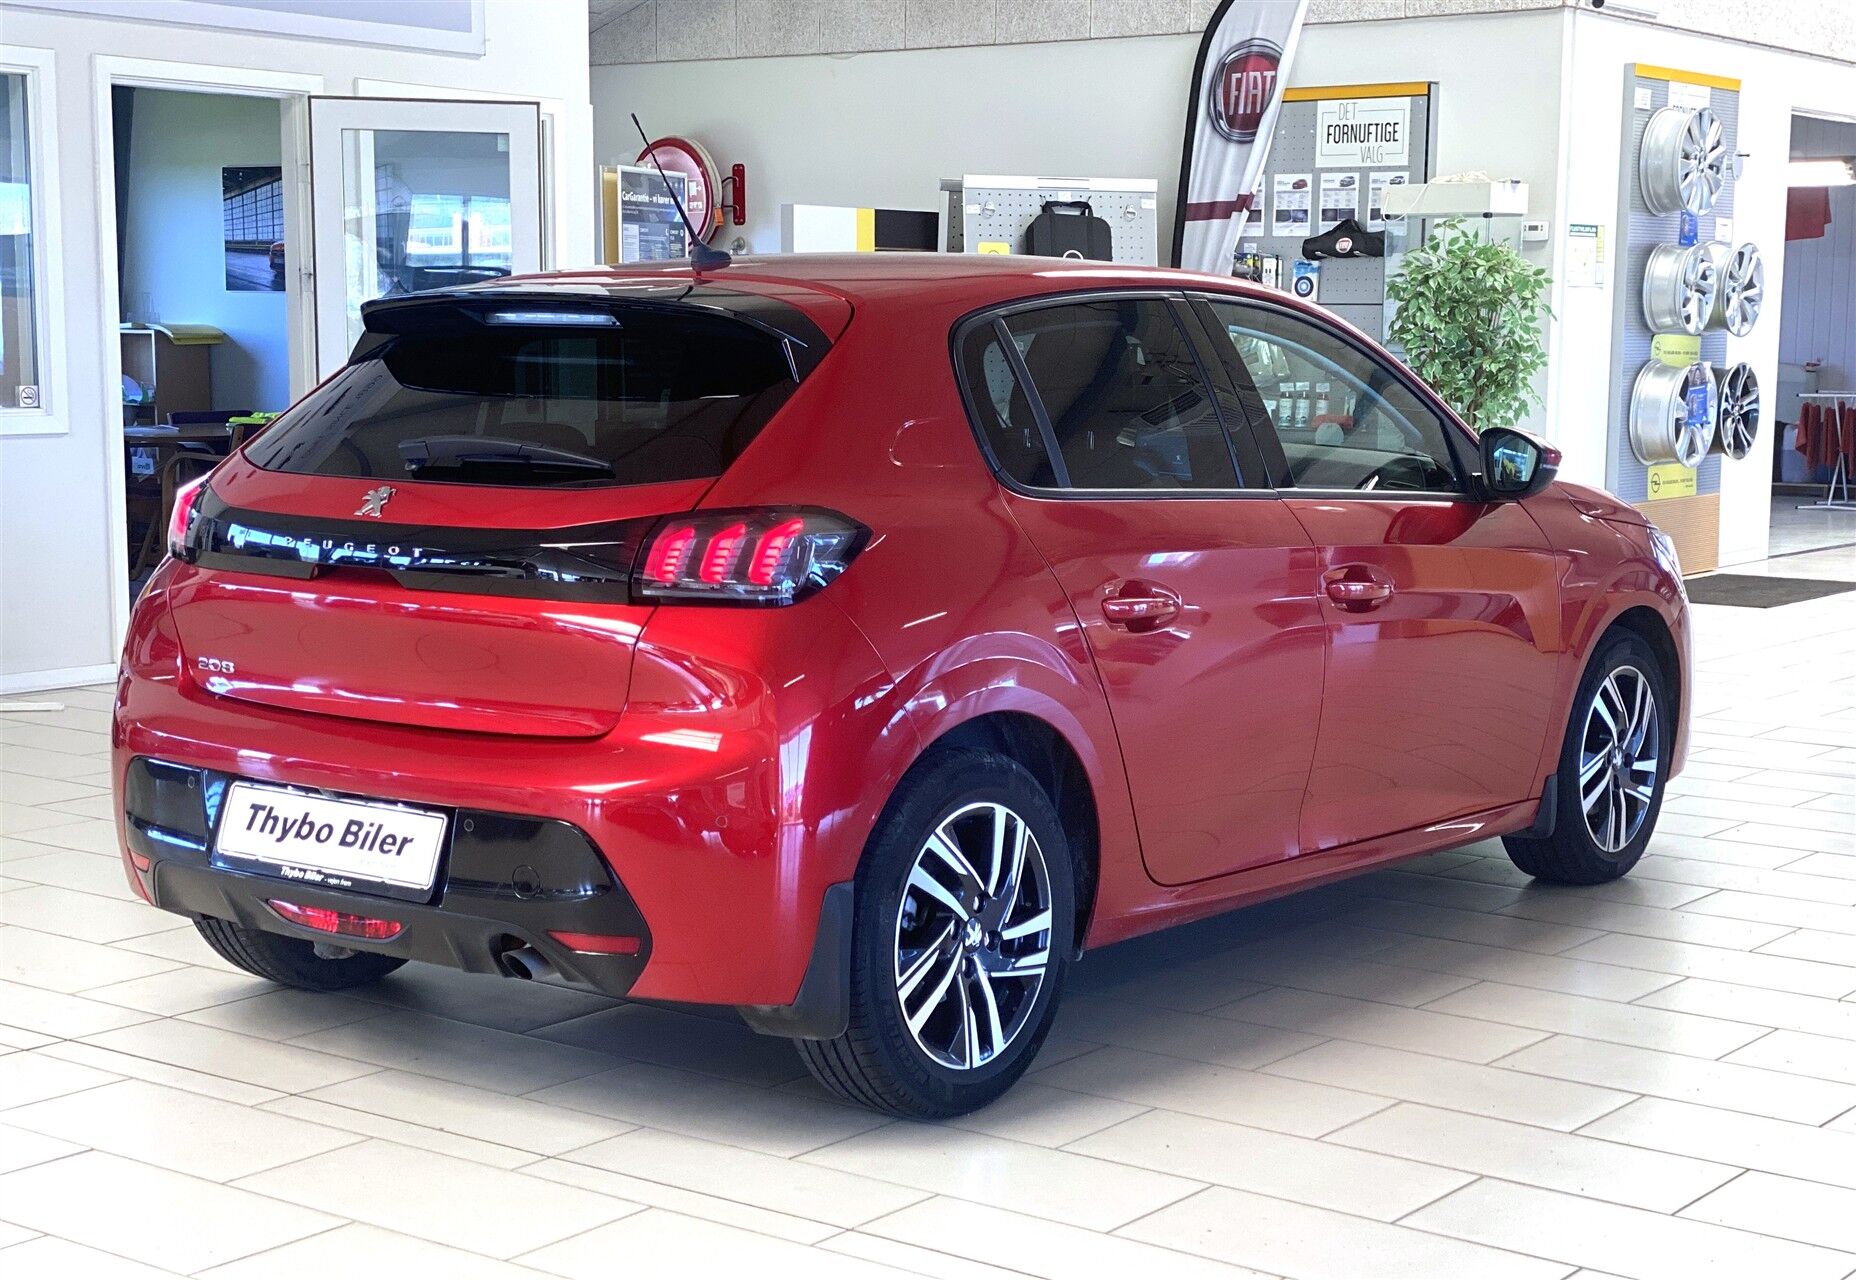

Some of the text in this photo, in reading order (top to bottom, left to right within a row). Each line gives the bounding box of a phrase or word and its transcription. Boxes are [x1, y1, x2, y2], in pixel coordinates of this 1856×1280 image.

[1229, 71, 1276, 115] FIAT
[1338, 102, 1358, 121] DET
[1326, 122, 1399, 144] FORNUFTIGE
[1360, 145, 1384, 163] VALG
[284, 535, 423, 558] PEUGEOT
[197, 656, 235, 674] 208
[246, 804, 414, 856] Thybo Biler
[281, 866, 304, 878] Thybo
[304, 870, 324, 882] Biler
